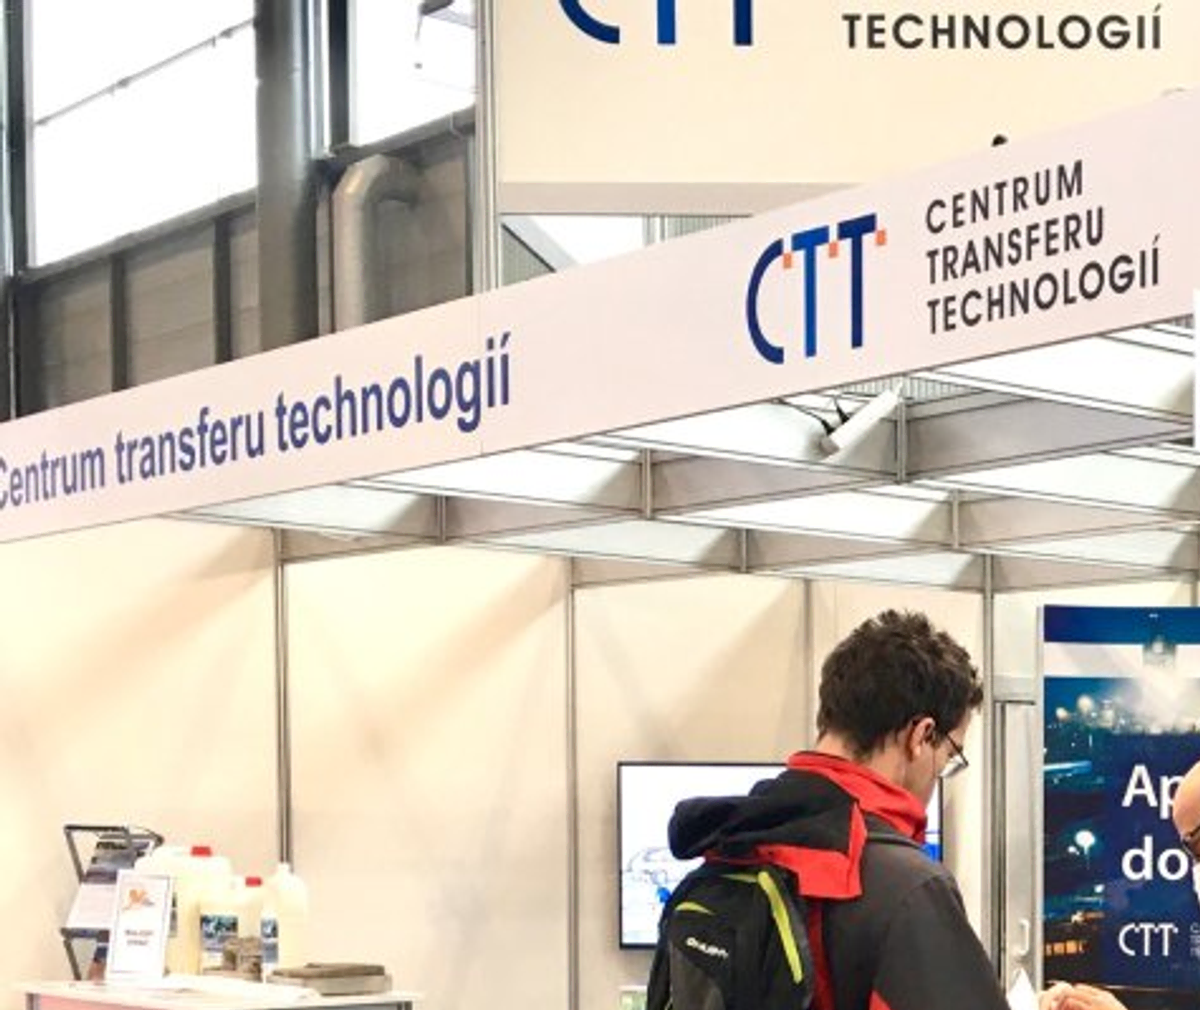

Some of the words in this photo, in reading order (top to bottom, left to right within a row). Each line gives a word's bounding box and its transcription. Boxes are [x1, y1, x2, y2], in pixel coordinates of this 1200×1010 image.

[842, 3, 1163, 49] TECHNOLOGIÍ
[926, 161, 1082, 234] CENTRUM
[927, 206, 1104, 285] TRANSFERU
[927, 234, 1160, 334] TECHNOLOGIÍ
[746, 212, 887, 364] CTT
[115, 407, 265, 484] transferu
[275, 331, 511, 452] technologií
[1118, 922, 1178, 956] CTT
